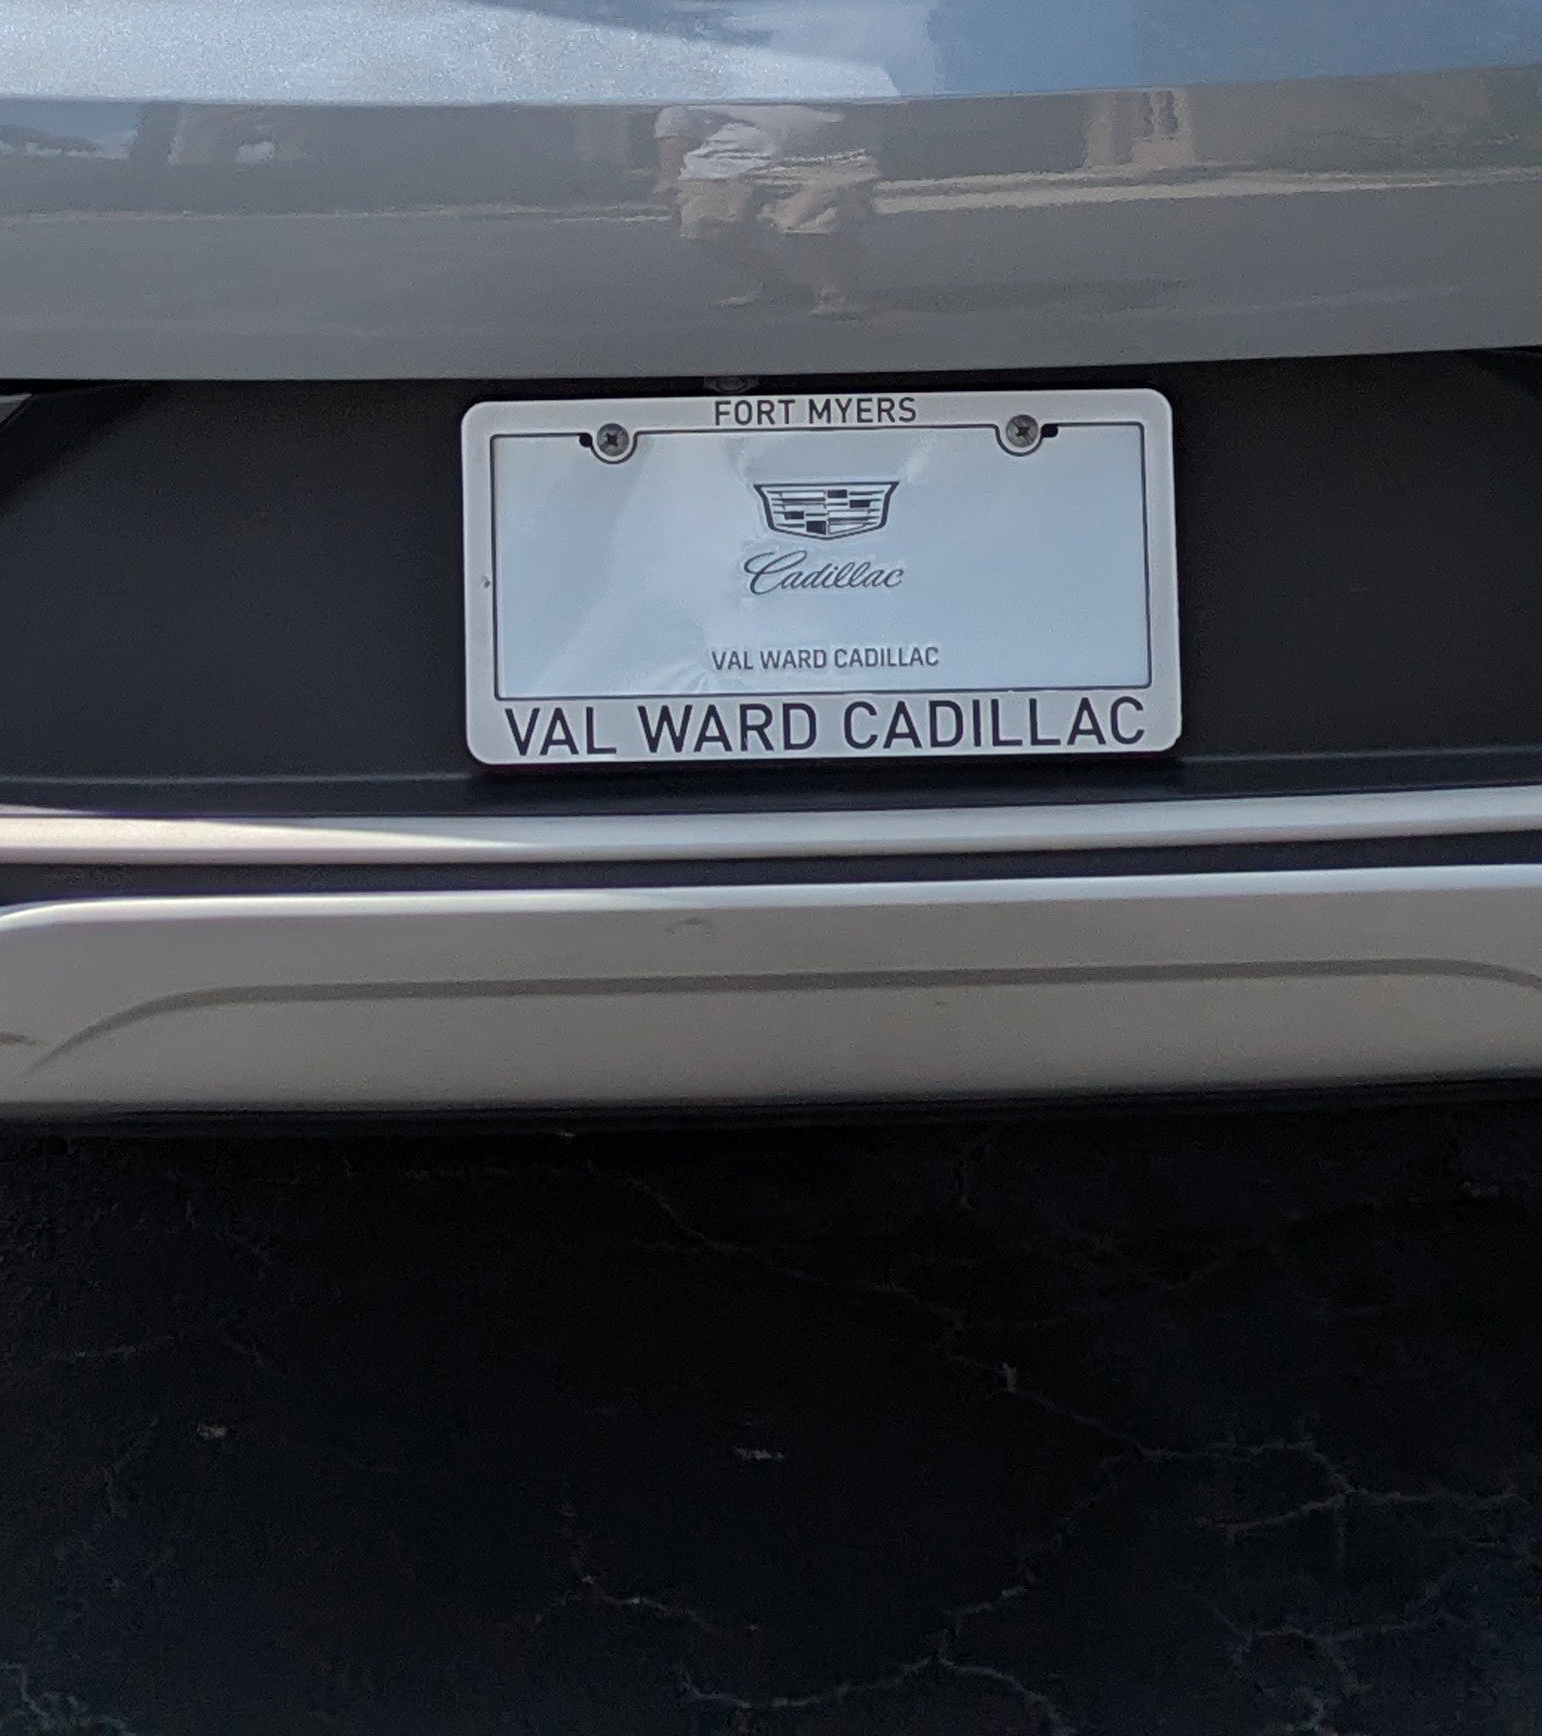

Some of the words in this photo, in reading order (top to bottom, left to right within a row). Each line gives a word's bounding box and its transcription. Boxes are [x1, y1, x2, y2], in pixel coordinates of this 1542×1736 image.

[714, 399, 795, 426] FORT
[809, 397, 916, 424] MYERS
[743, 550, 904, 595] Cadillac
[711, 650, 754, 670] VAL
[760, 649, 827, 669] WARD
[834, 646, 940, 668] CADILLAC
[505, 707, 616, 756] VAL
[637, 703, 817, 753] WARD
[843, 697, 1145, 749] CADILLAC
